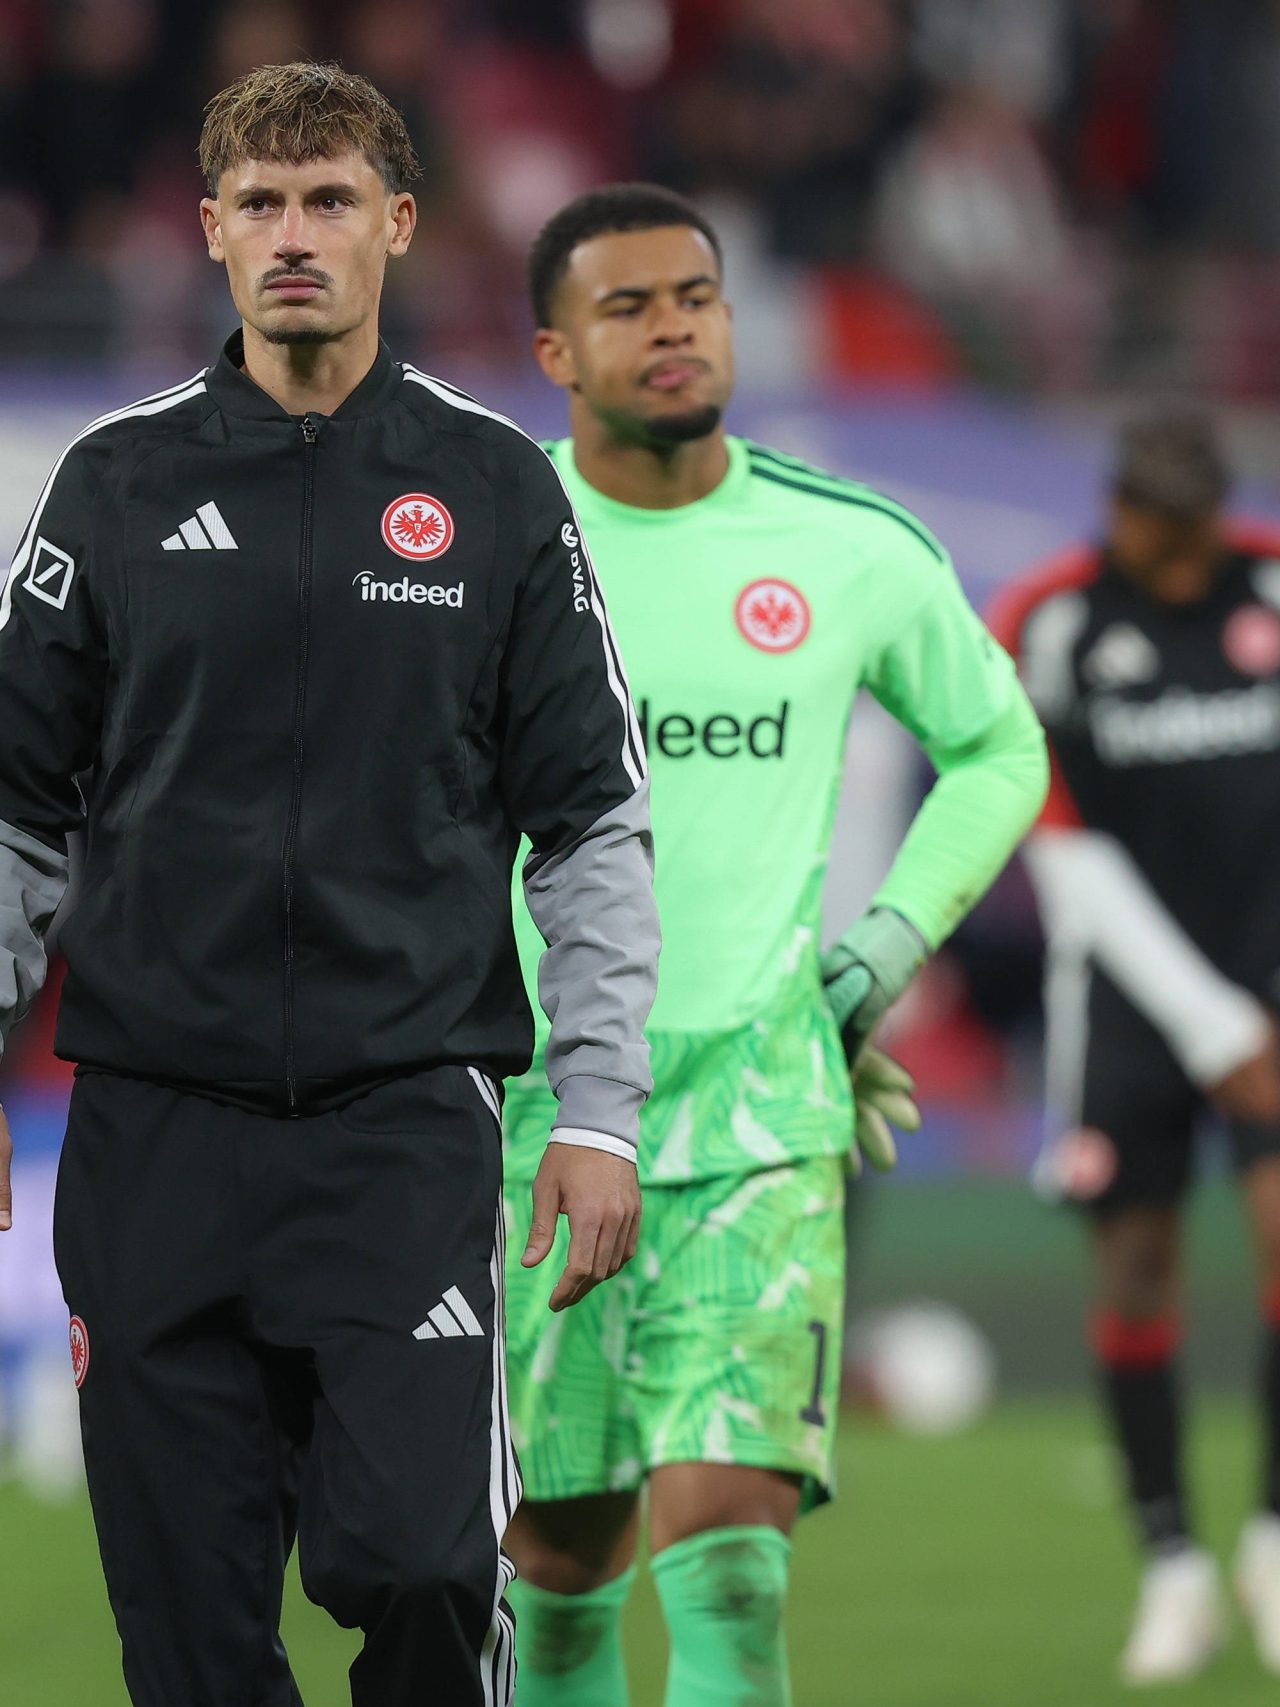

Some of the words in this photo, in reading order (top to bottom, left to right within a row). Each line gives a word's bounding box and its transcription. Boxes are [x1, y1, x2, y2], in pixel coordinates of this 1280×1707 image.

[352, 570, 464, 608] indeed
[570, 551, 590, 613] DVAG
[799, 1320, 826, 1428] 1
